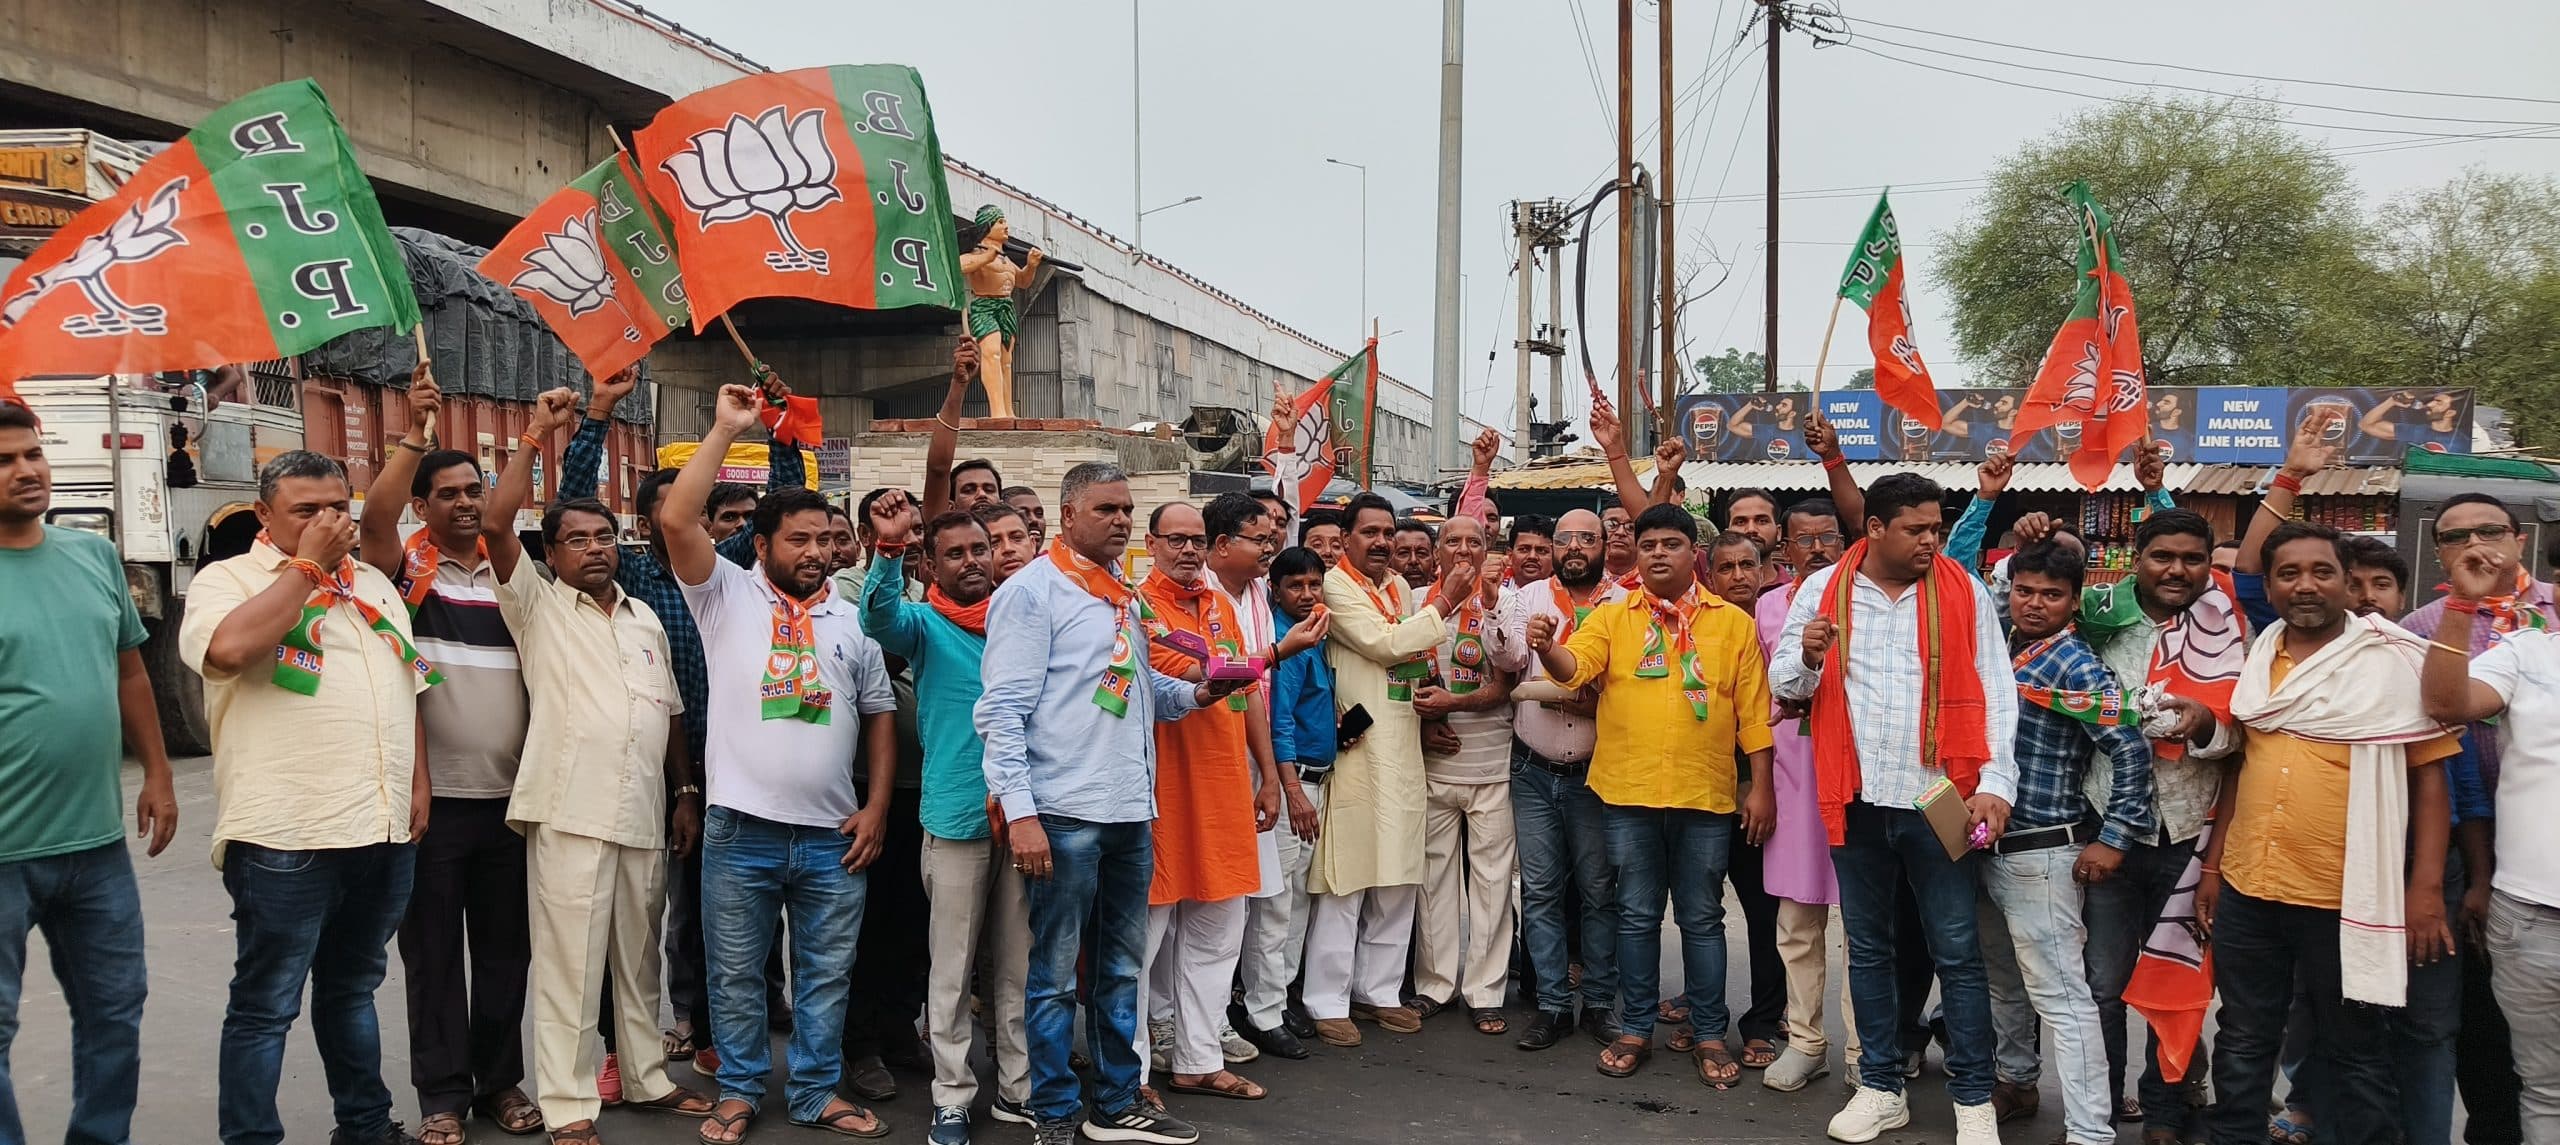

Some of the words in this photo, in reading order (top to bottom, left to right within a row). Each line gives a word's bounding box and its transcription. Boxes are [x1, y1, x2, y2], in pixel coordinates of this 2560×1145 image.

[1829, 402, 1859, 413] NEW
[2223, 400, 2259, 412] NEW
[1827, 418, 1870, 429] ANDAL
[2208, 418, 2273, 430] MANDAL
[1838, 434, 1877, 445] HOTEL
[2198, 435, 2230, 447] LINE
[2234, 436, 2281, 448] HOTEL
[726, 468, 749, 479] GOODS
[1455, 668, 1480, 681] B.J.P.
